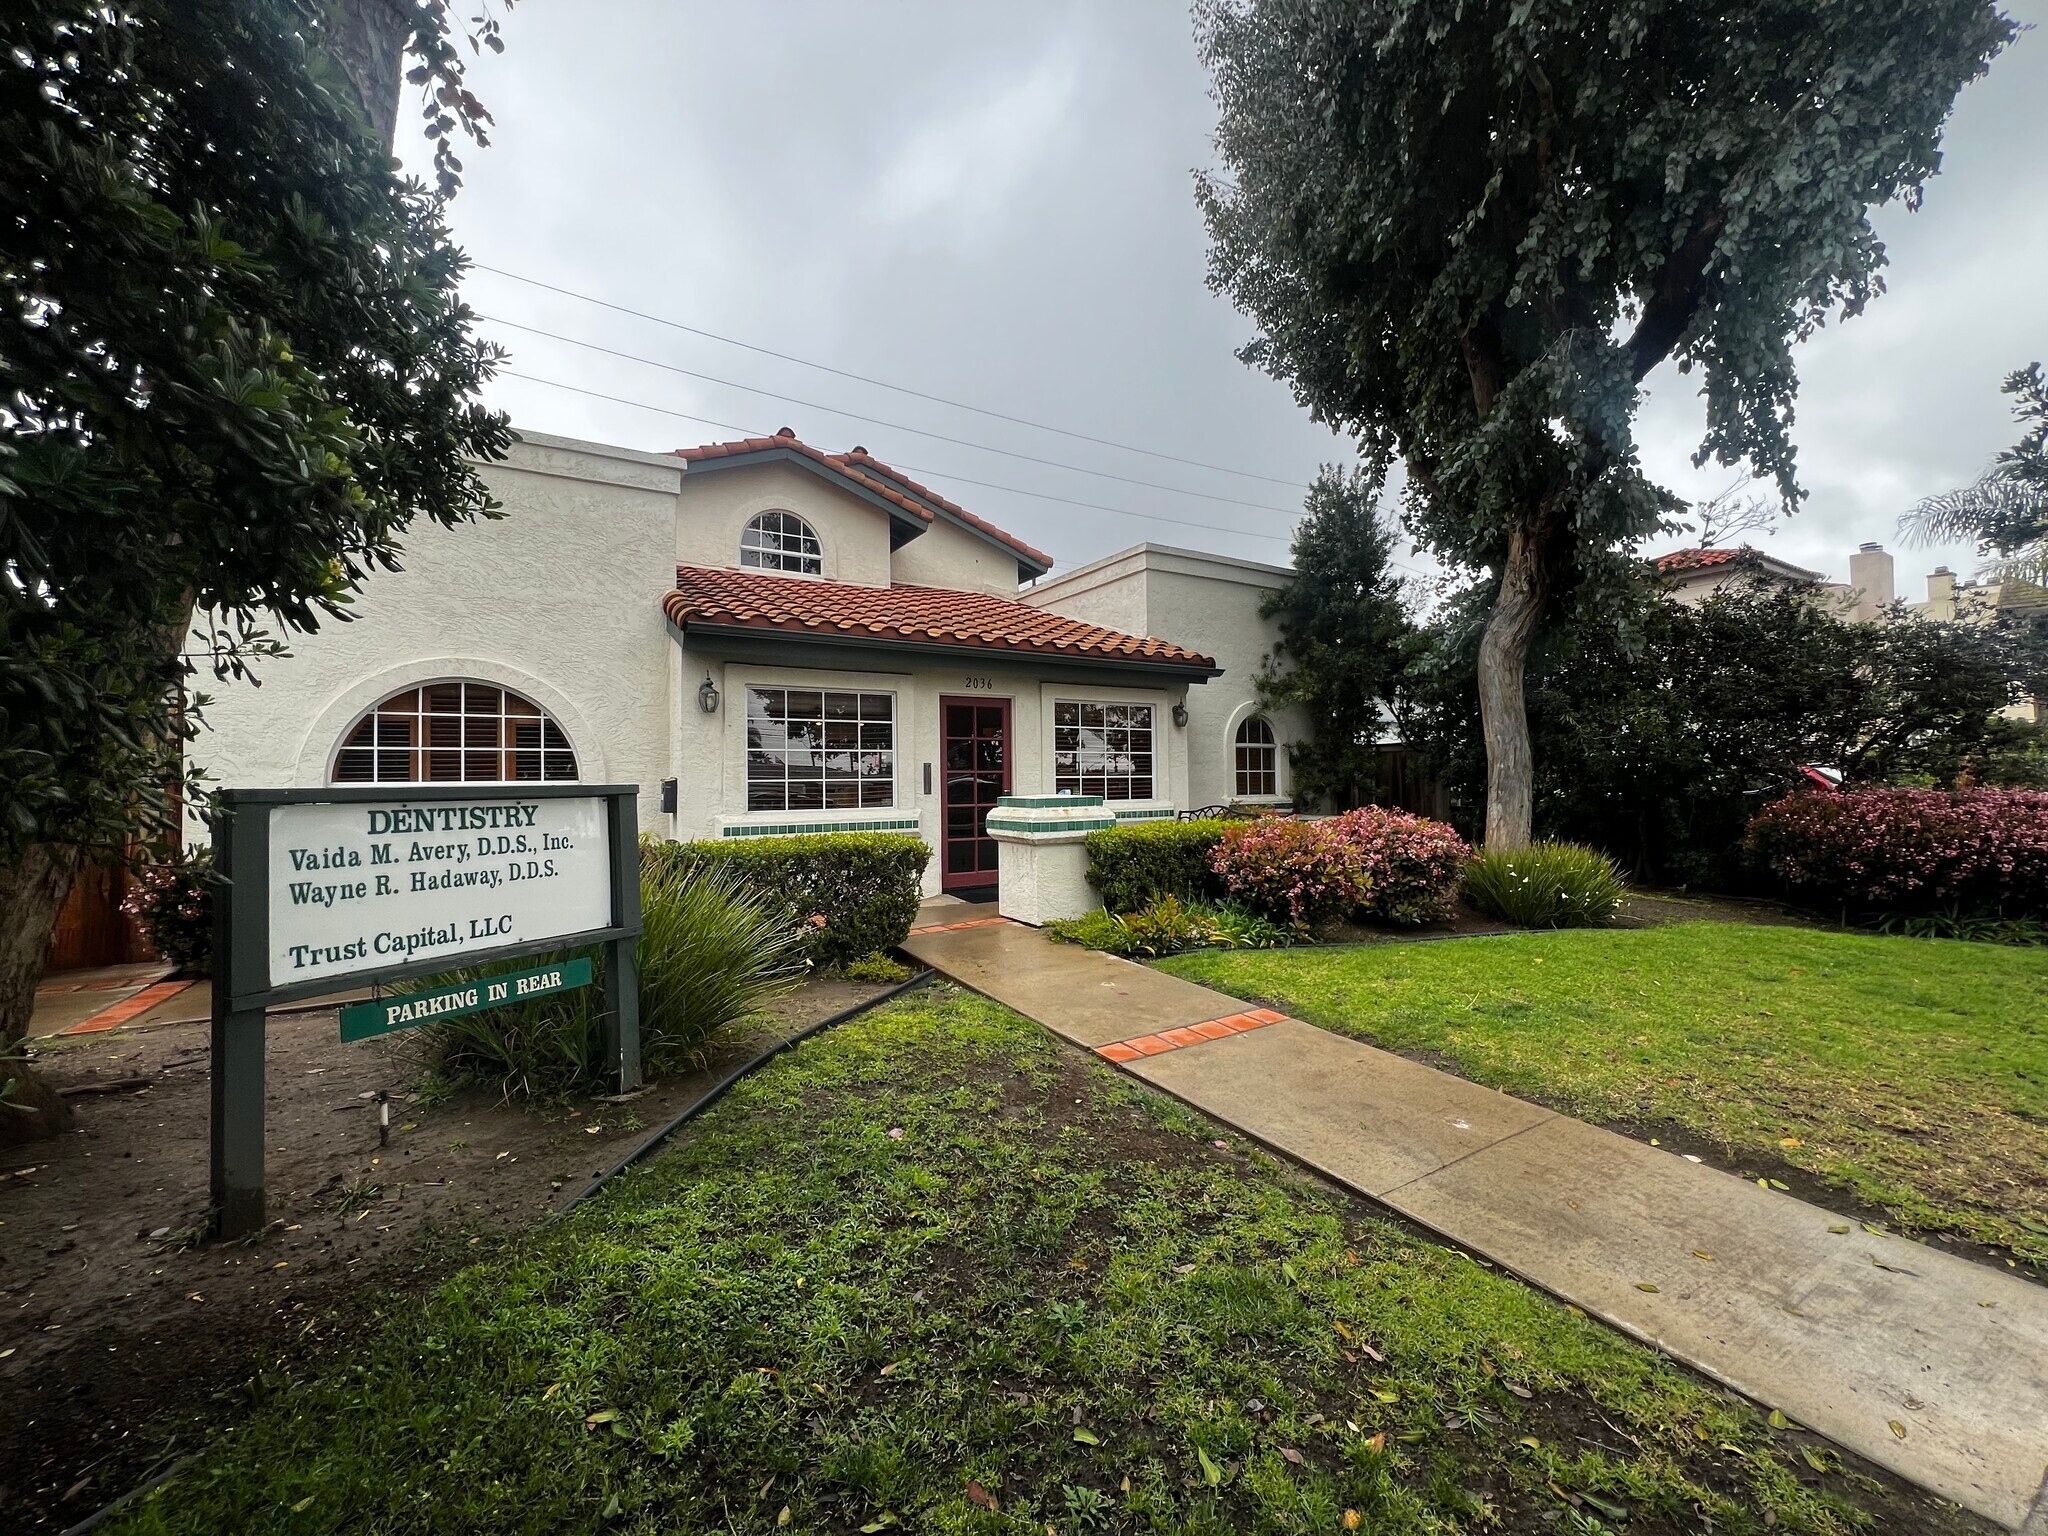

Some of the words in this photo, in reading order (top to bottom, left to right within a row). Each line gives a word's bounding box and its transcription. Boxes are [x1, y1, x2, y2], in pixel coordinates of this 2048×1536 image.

[965, 677, 993, 689] 2036
[367, 804, 538, 835] DENTISTRY
[289, 848, 361, 872] Vaida
[371, 843, 399, 865] M.
[408, 840, 470, 863] Avery,
[478, 836, 536, 857] D.D.S.,
[542, 832, 574, 851] Inc.
[289, 881, 367, 907] Wayne
[376, 876, 399, 896] R.
[410, 869, 503, 893] Hadaway,
[509, 860, 559, 882] D.D.S.
[289, 938, 366, 969] Trust
[373, 924, 463, 955] Capital,
[469, 915, 512, 939] LLC
[386, 988, 478, 1025] PARKING
[488, 981, 507, 1001] IN
[517, 971, 562, 993] REAR
